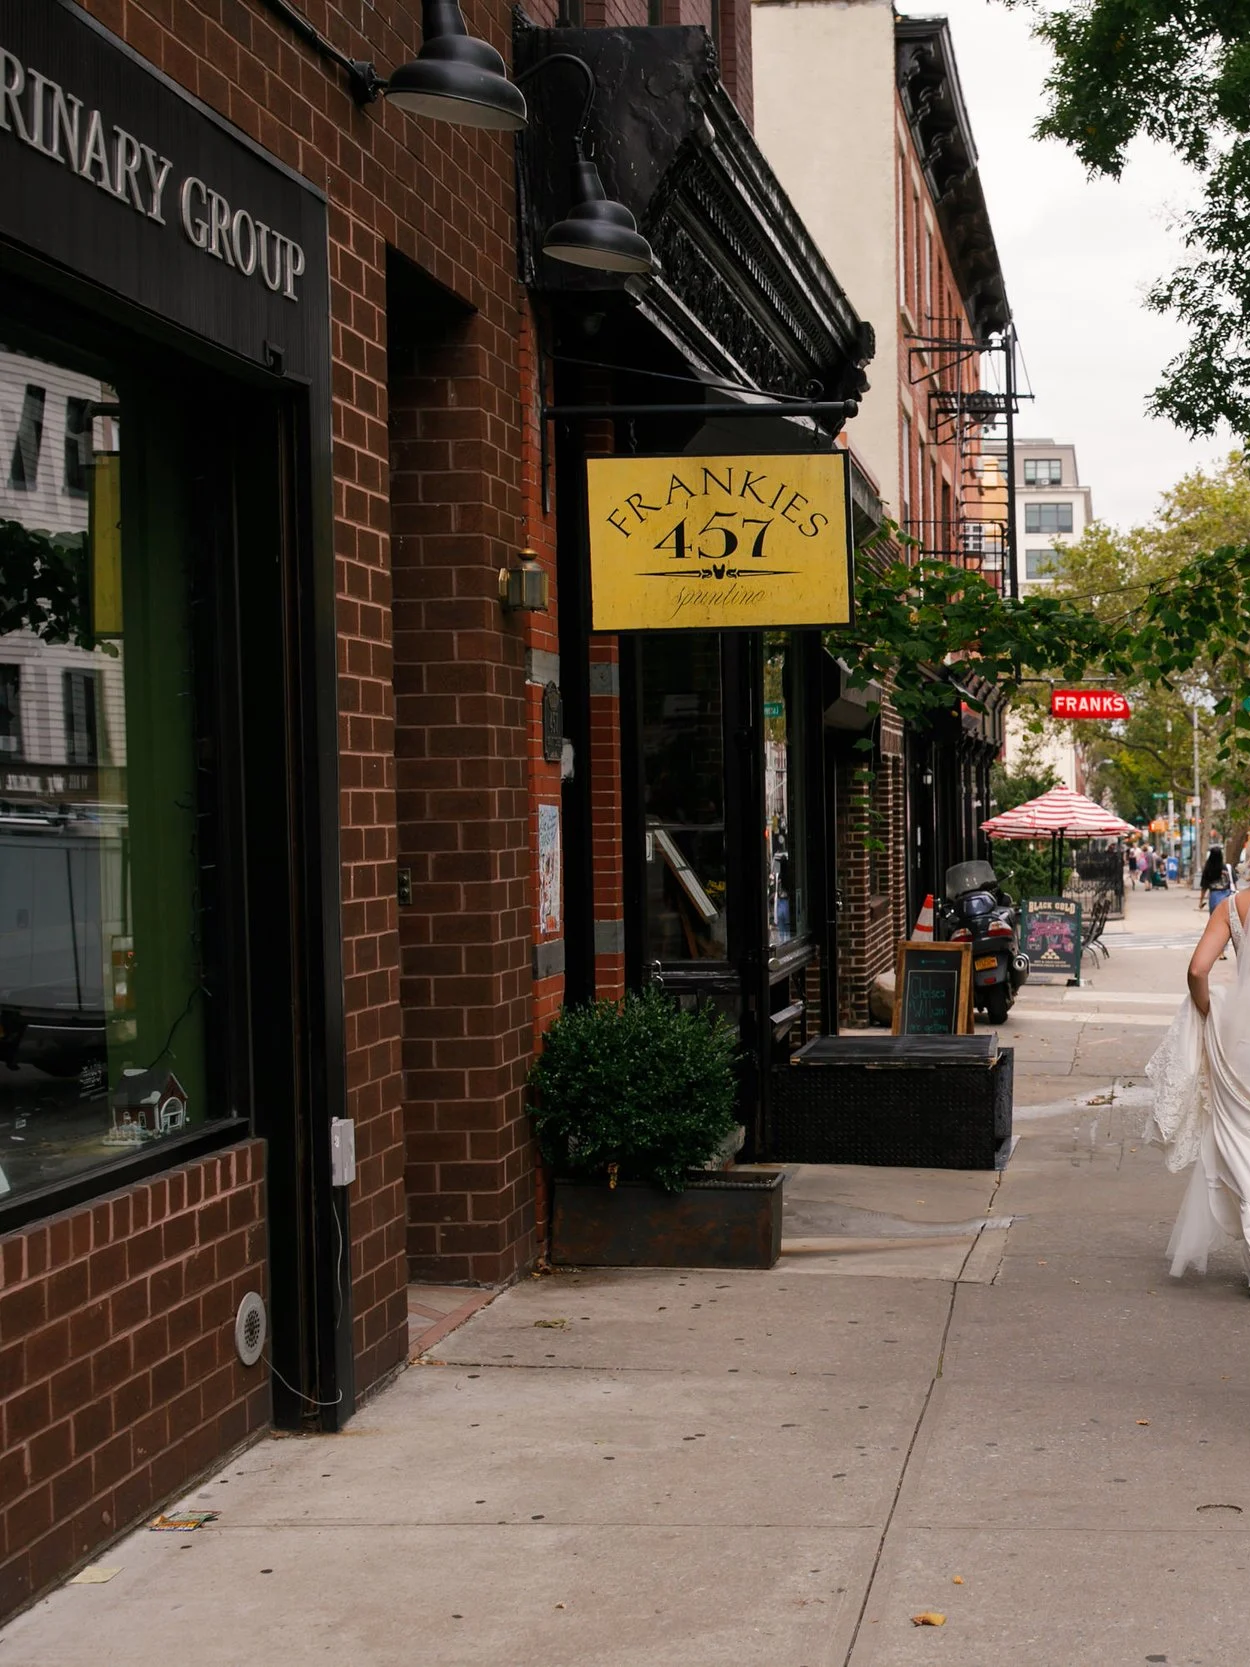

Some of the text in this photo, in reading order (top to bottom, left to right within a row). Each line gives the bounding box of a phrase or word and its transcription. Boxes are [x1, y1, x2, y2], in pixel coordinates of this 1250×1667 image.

[181, 176, 305, 301] GROUP
[606, 467, 829, 538] FRANKIES
[653, 511, 775, 559] 457
[1028, 901, 1076, 915] BLACK GOLD
